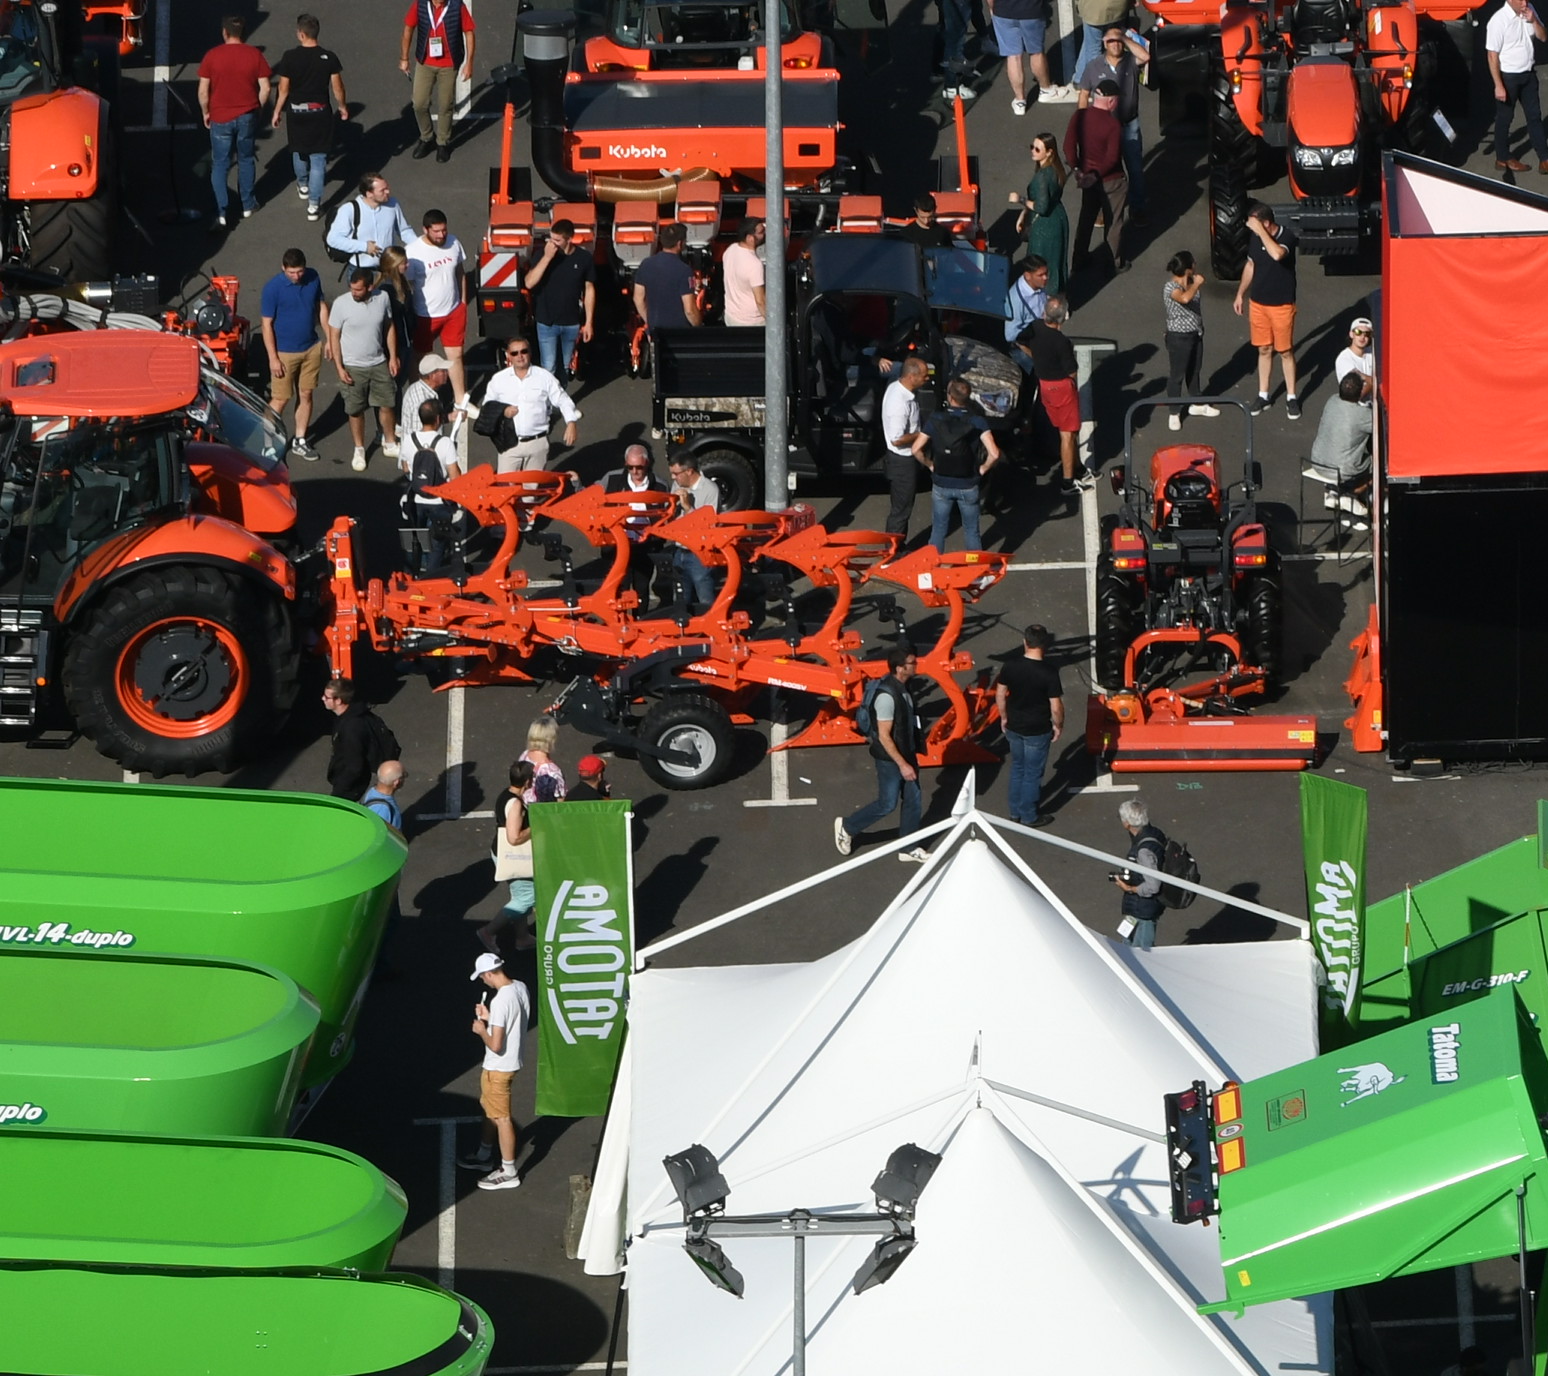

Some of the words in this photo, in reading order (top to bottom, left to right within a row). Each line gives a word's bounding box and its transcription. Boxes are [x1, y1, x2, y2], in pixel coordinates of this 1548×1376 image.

[608, 145, 668, 159] Kubota
[670, 412, 711, 423] Kubota
[1441, 969, 1531, 996] EM-G-310-F
[1431, 1022, 1460, 1084] Tatoma
